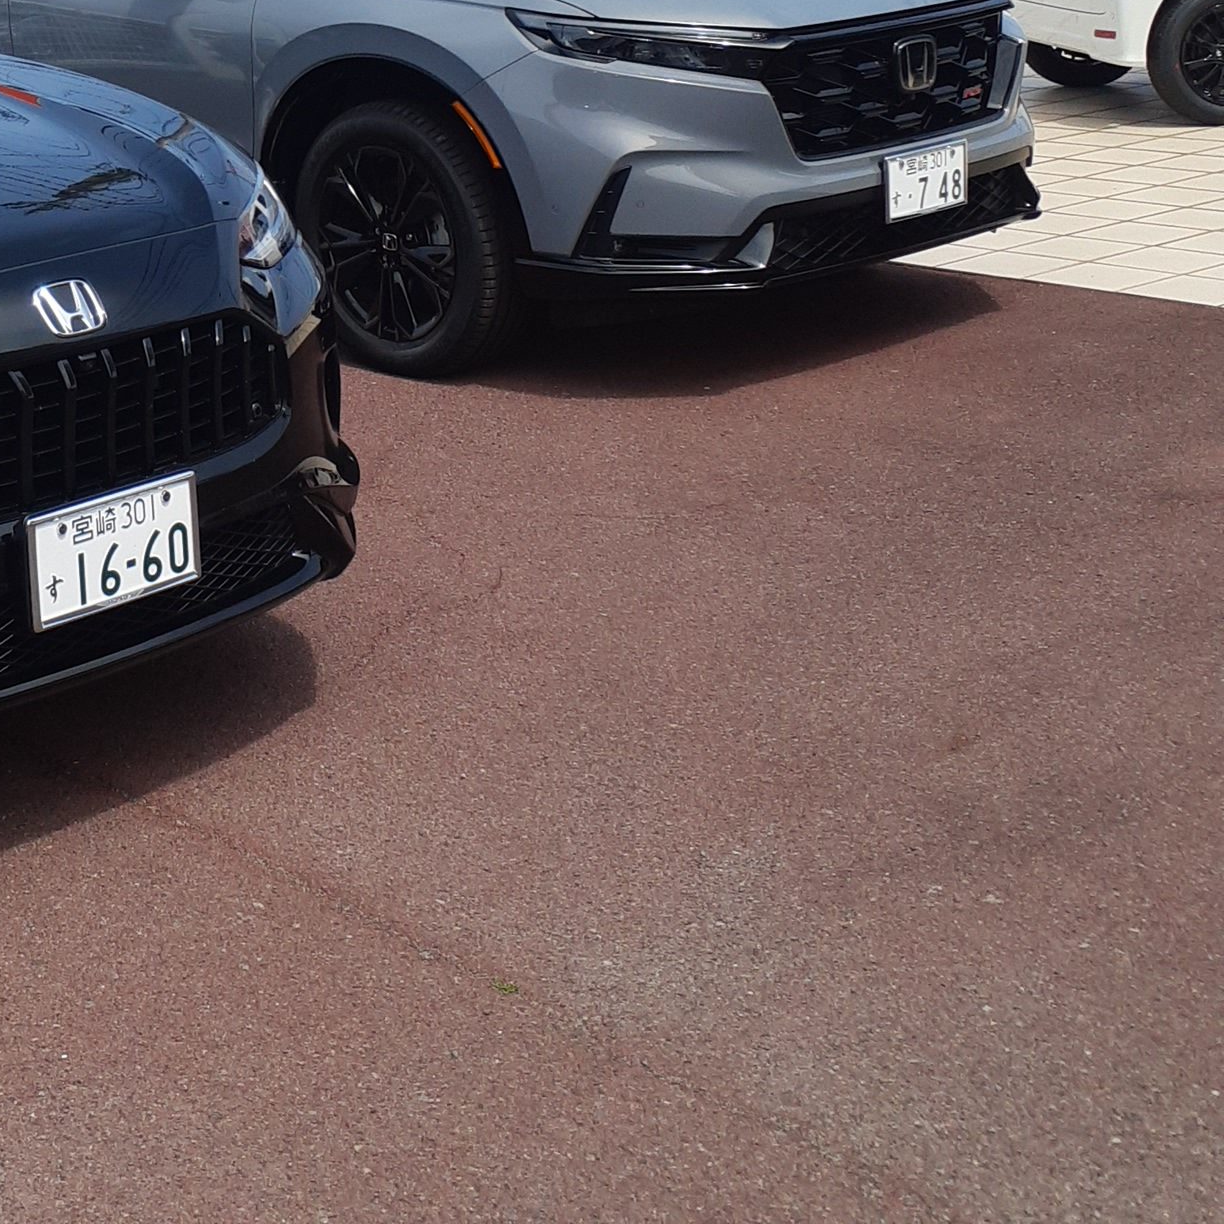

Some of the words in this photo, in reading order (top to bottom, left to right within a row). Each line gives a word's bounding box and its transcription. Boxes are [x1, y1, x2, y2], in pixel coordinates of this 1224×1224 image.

[72, 507, 117, 545] 宮崎
[121, 494, 155, 529] 301
[45, 575, 64, 604] す
[78, 522, 189, 605] 16-60
